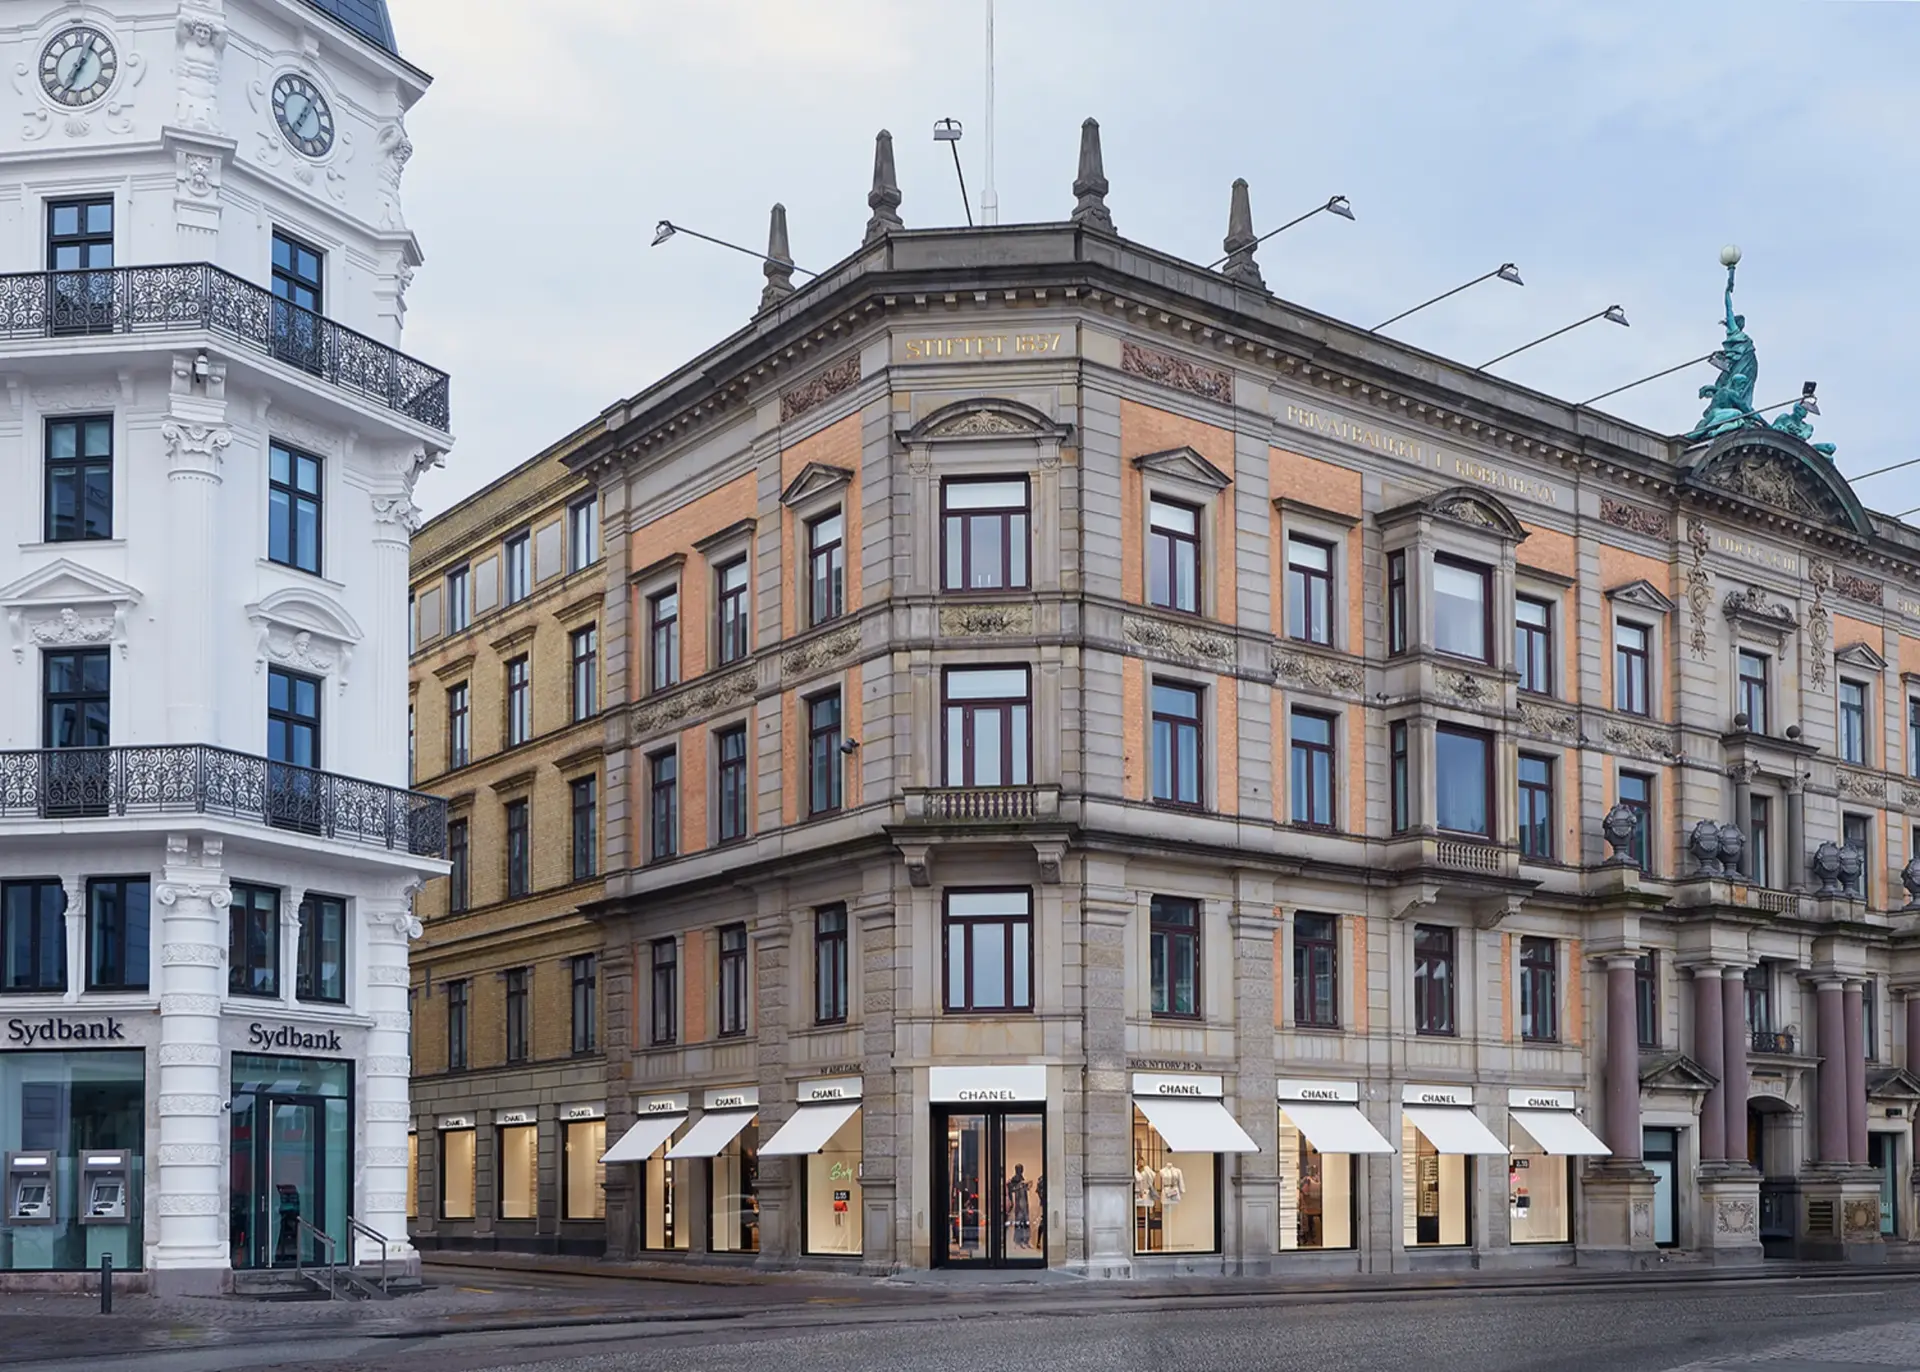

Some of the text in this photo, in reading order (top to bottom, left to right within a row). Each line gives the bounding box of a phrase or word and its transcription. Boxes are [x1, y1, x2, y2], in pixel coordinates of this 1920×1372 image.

[906, 333, 1061, 359] STIFTET 1857
[8, 1017, 125, 1045] Sydbank
[248, 1023, 342, 1050] Sydbank
[812, 1089, 843, 1099] CHANEL
[1159, 1084, 1201, 1094] CHANEL
[959, 1090, 1015, 1100] CHANEL
[1301, 1090, 1339, 1099] CHANEL
[1422, 1094, 1456, 1103] CHANEL
[716, 1098, 742, 1106] CHANEL
[1528, 1098, 1560, 1107] CHANEL
